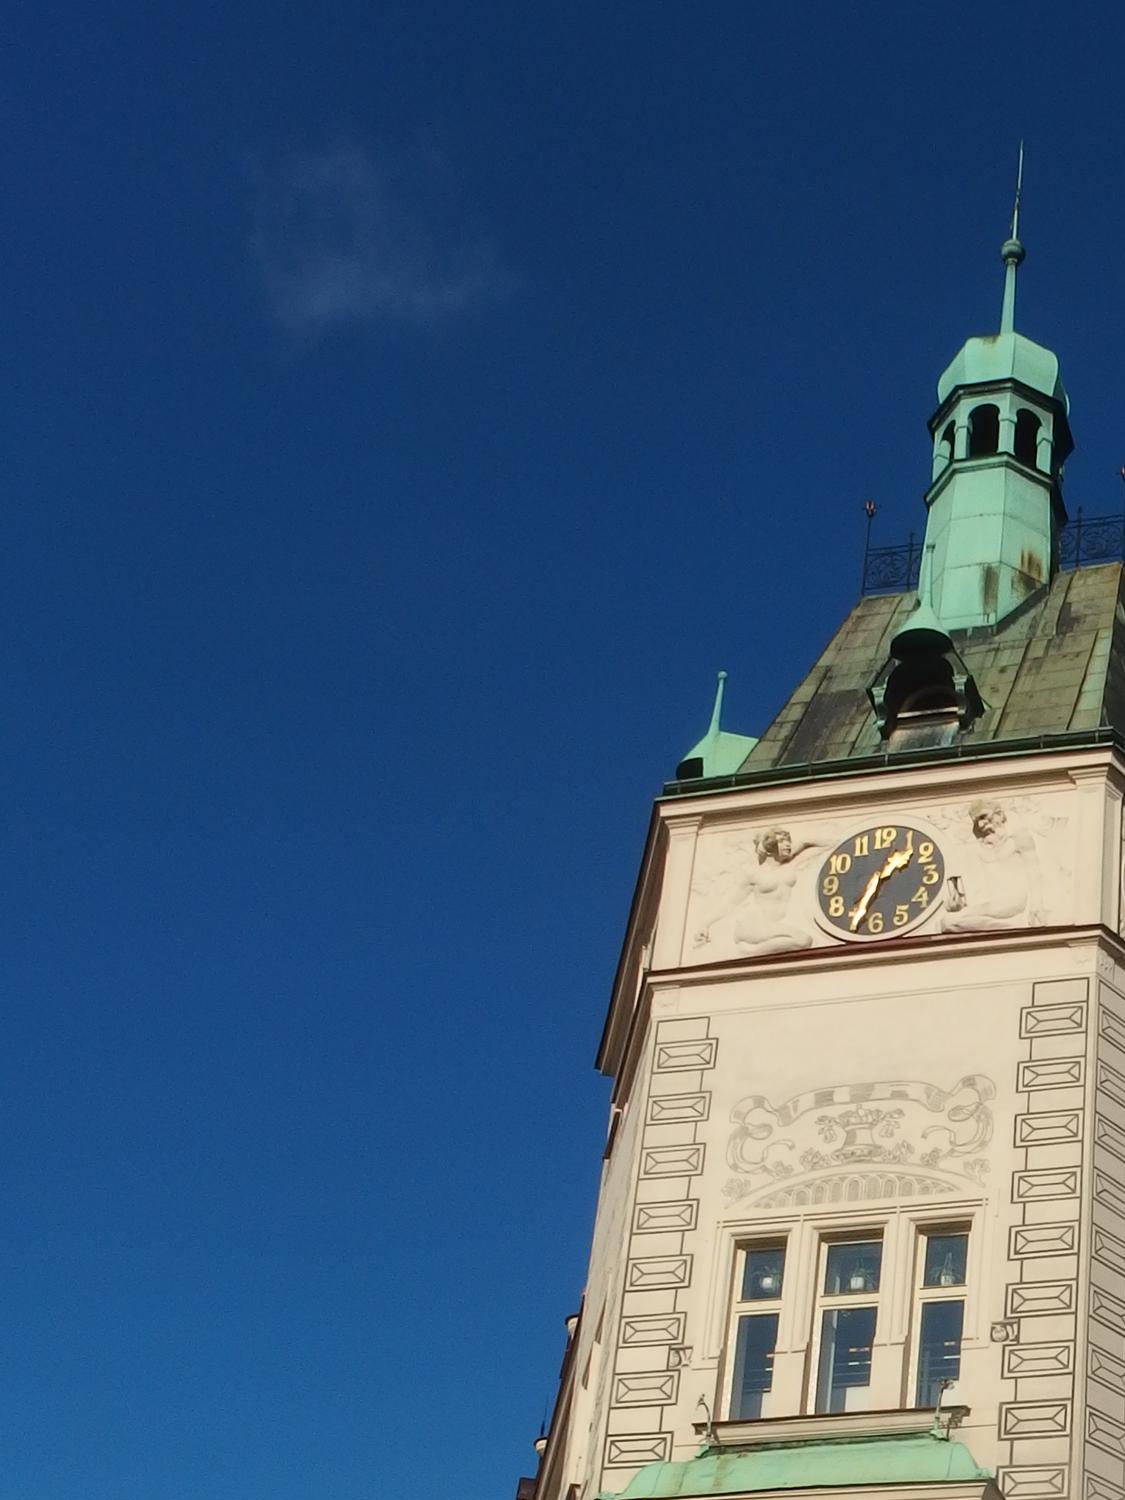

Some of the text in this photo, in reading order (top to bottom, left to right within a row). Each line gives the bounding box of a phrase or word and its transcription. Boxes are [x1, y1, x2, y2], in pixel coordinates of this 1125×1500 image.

[855, 834, 870, 857] 11
[918, 842, 934, 864] 2
[829, 853, 851, 875] 10
[922, 864, 940, 885] 3
[822, 875, 840, 896] 9
[828, 896, 845, 918] 8
[911, 886, 930, 908] 4
[867, 912, 884, 934] 6
[892, 904, 910, 926] 5
